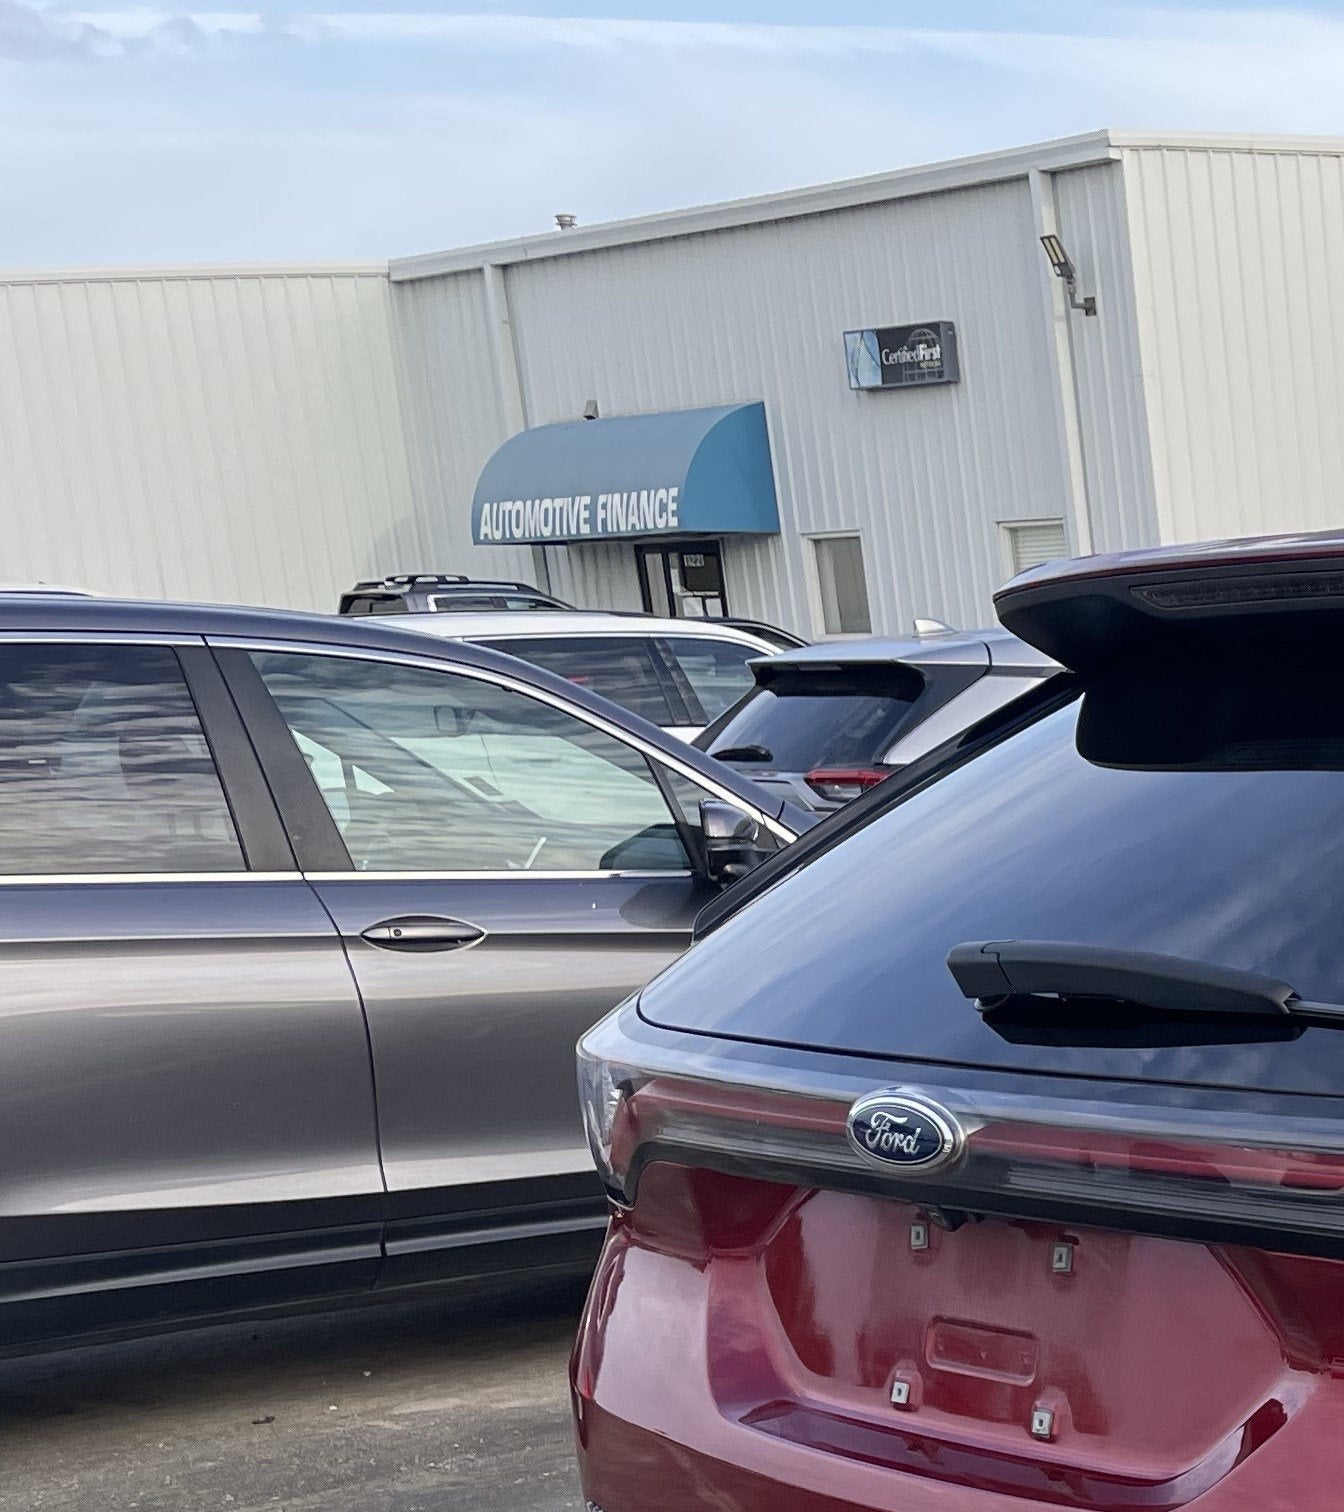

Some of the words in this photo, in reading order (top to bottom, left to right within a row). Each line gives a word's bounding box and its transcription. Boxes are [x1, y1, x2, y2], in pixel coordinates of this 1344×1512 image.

[480, 495, 591, 540] AUTOMOTIVE
[597, 487, 679, 533] FINANCE
[865, 1111, 922, 1155] Ford
